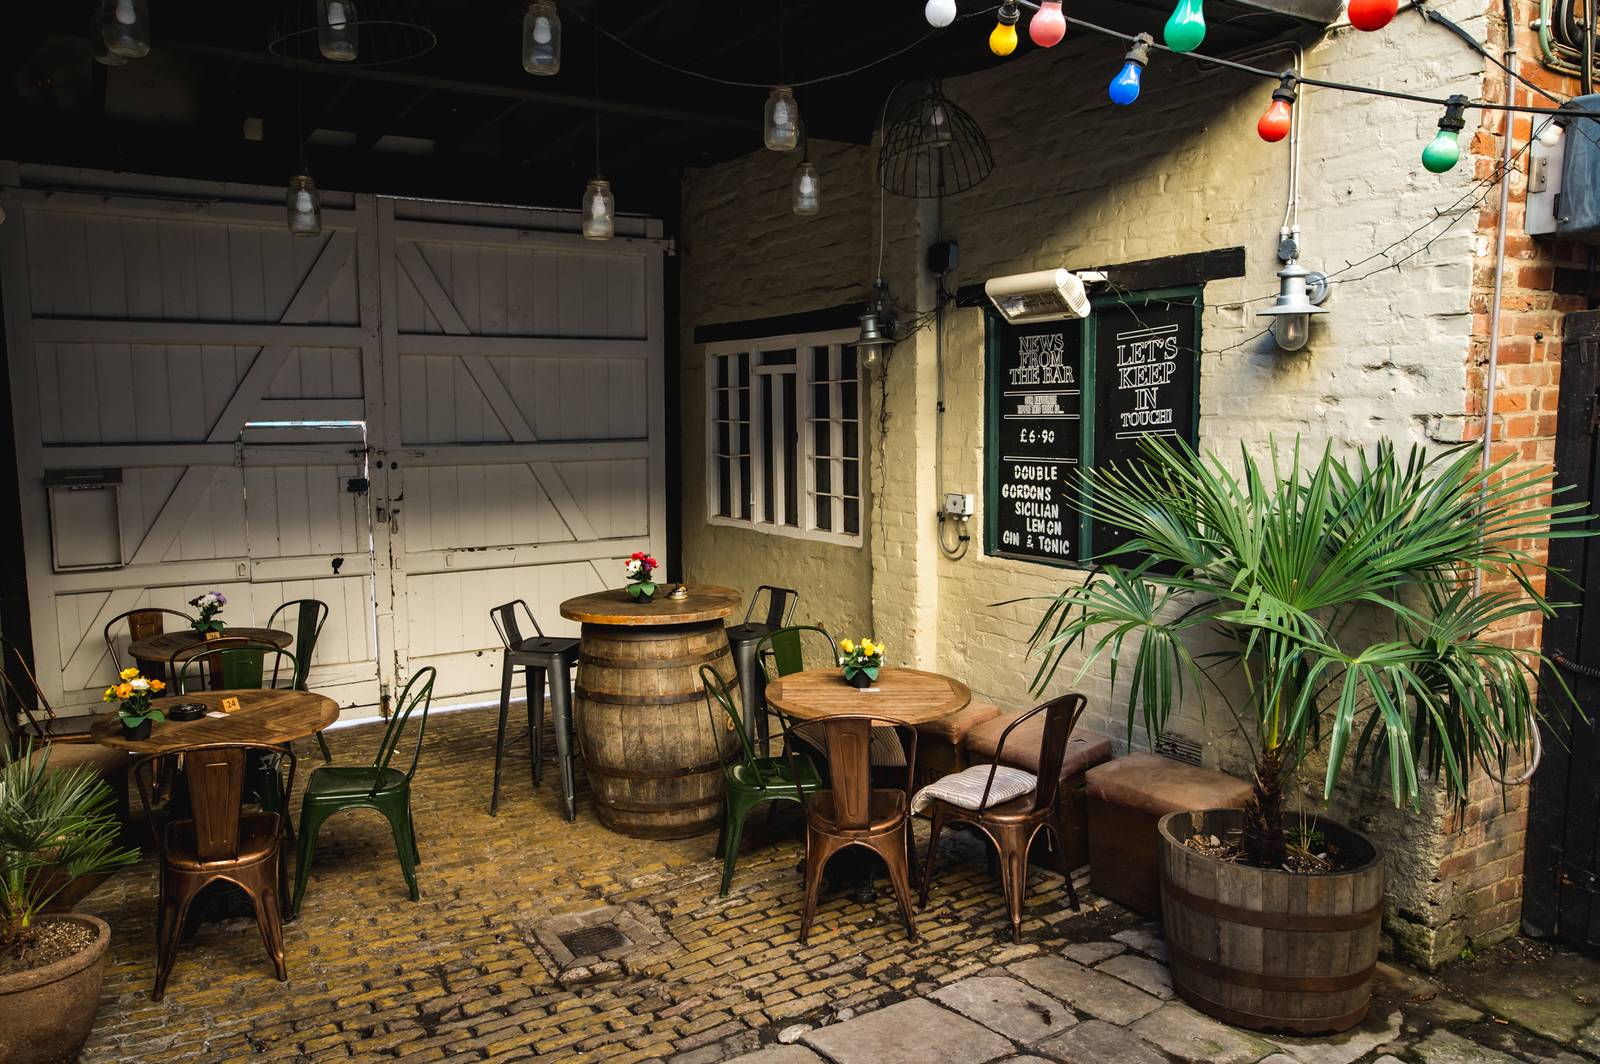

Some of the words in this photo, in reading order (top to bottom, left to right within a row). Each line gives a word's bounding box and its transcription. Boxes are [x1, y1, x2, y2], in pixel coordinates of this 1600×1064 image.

[1019, 333, 1064, 352] NEWS
[1117, 336, 1178, 367] LET'S
[1019, 350, 1064, 369] FROM
[1009, 368, 1040, 385] THE
[1042, 366, 1075, 384] BAR
[1118, 361, 1177, 389] KEEP
[1134, 386, 1159, 411] IN
[1120, 408, 1173, 427] TOUCH!
[1014, 465, 1058, 481] DOUBLE
[1002, 483, 1052, 500] GORDONS
[1015, 501, 1059, 519] SICILIAN
[1026, 517, 1062, 536] LEMON
[1003, 530, 1020, 547] GIN
[1026, 534, 1035, 550] &
[1038, 535, 1070, 554] TONIC
